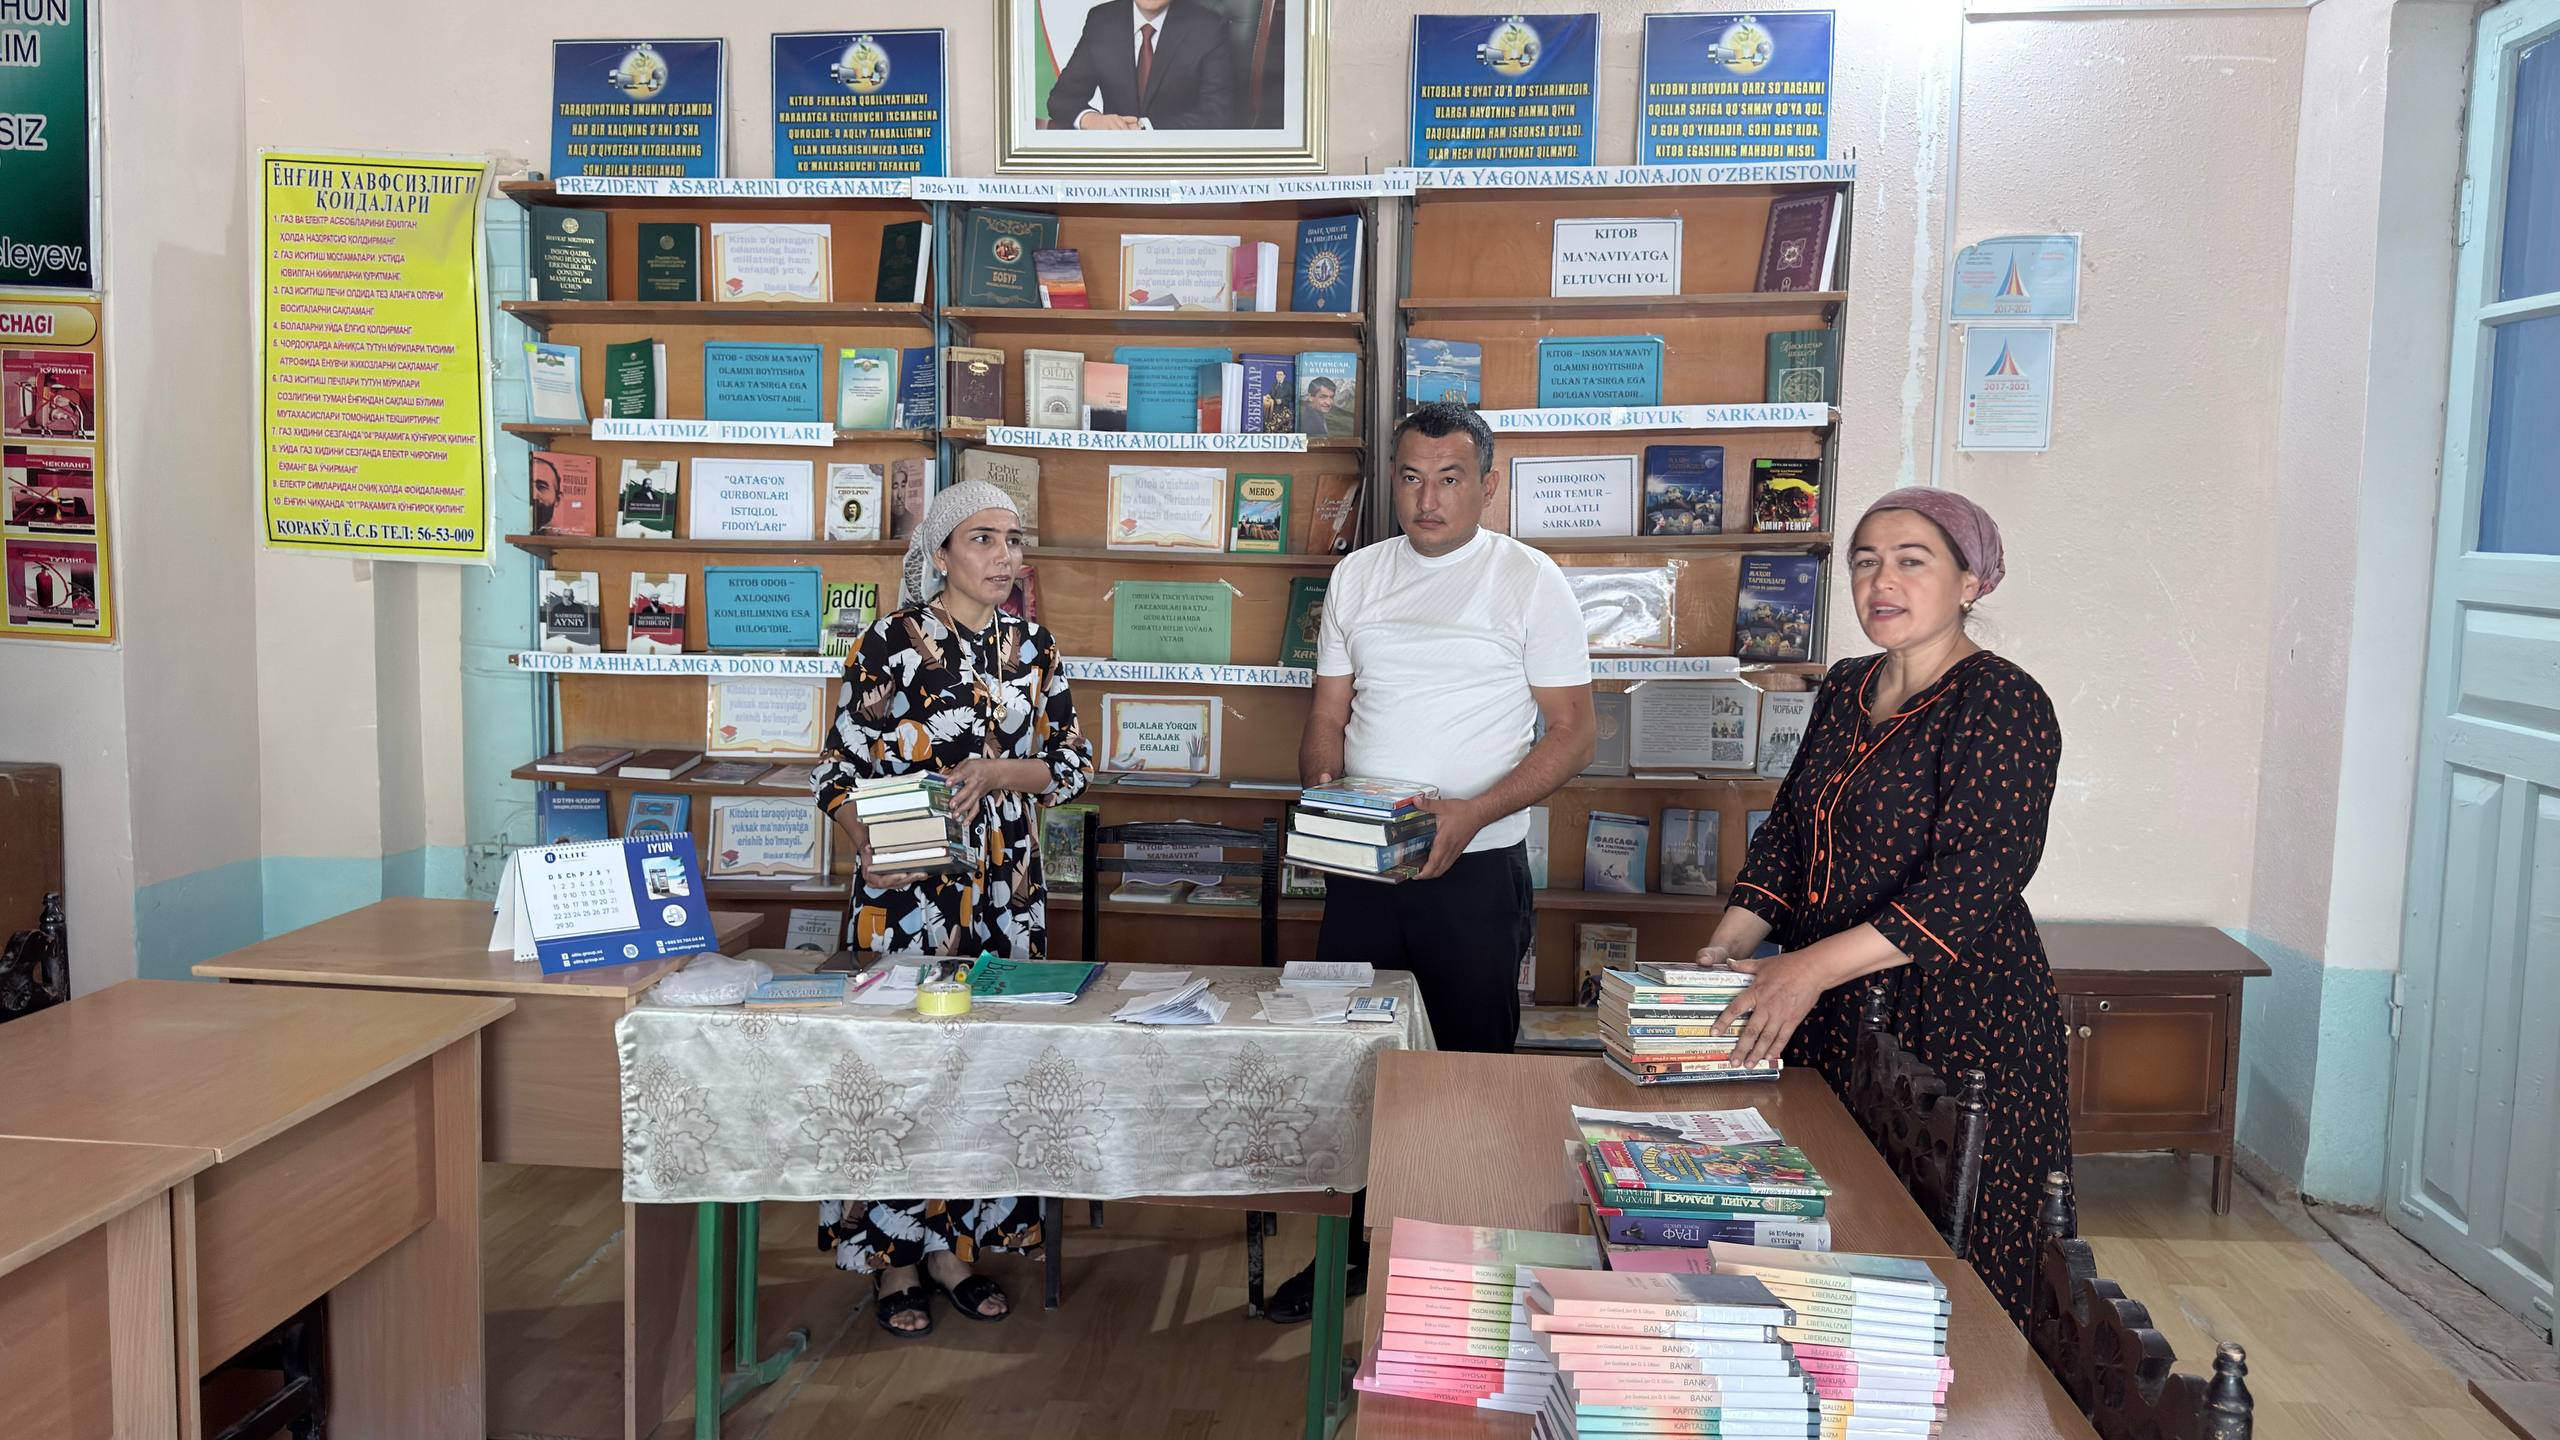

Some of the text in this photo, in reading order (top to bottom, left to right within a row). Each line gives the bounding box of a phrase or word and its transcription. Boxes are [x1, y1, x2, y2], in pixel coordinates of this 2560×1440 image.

[0, 34, 37, 63] IM
[273, 163, 476, 194] ЁНҒИН ХАВФСИЗЛИГИ
[1440, 169, 1464, 185] VA
[1473, 169, 1608, 185] YAGONAMSAN
[1615, 168, 1700, 184] JONAJON
[559, 178, 657, 194] PREZIDENT
[669, 180, 780, 195] ASARLARINI
[920, 179, 1409, 198] 2026-YIL MAHALLANI RIVOJLANTIRISH VA JAMIYATNI YUKSALTIRISH YILI
[1596, 229, 1637, 239] KITOB
[0, 237, 87, 277] leyev.
[1563, 274, 1631, 284] ELTUVCHI
[1984, 383, 2030, 391] 2017-2021
[1499, 413, 1611, 427] BUNYODKOR
[604, 423, 821, 440] MILLATIMIZ FIDOIYLARI
[989, 428, 1303, 449] YOSHLAR BARKAMOLLIK ORZUSIDA
[1537, 473, 1606, 484] SOHIBQIRON
[721, 491, 788, 500] QURBONLARI
[1249, 488, 1275, 496] MEROS
[1534, 489, 1602, 499] AMIR TEMUR
[731, 507, 778, 516] ISTIQLOL
[1544, 504, 1599, 514] ADOLATLI
[1543, 519, 1601, 528] SARKARDA
[1761, 521, 1811, 530] АМИР ТЕМУР
[381, 525, 414, 540] ТЕЛ:
[418, 527, 474, 542] 56-53-009
[729, 579, 758, 587] KITOB
[824, 584, 878, 614] jadid
[521, 654, 842, 673] KITOB MAHHALLAMGA DONO MASLA
[1618, 659, 1710, 672] BURCHAGI
[1081, 663, 1203, 680] YAXSHILIKKA
[1211, 666, 1308, 685] YETAKLAR
[1166, 721, 1197, 730] YORQIN
[647, 842, 673, 853] IYUN
[1663, 1230, 1699, 1240] ГРАФ
[1665, 1309, 1688, 1317] BANK
[1670, 1362, 1692, 1370] BANK
[1683, 1378, 1706, 1386] BANK
